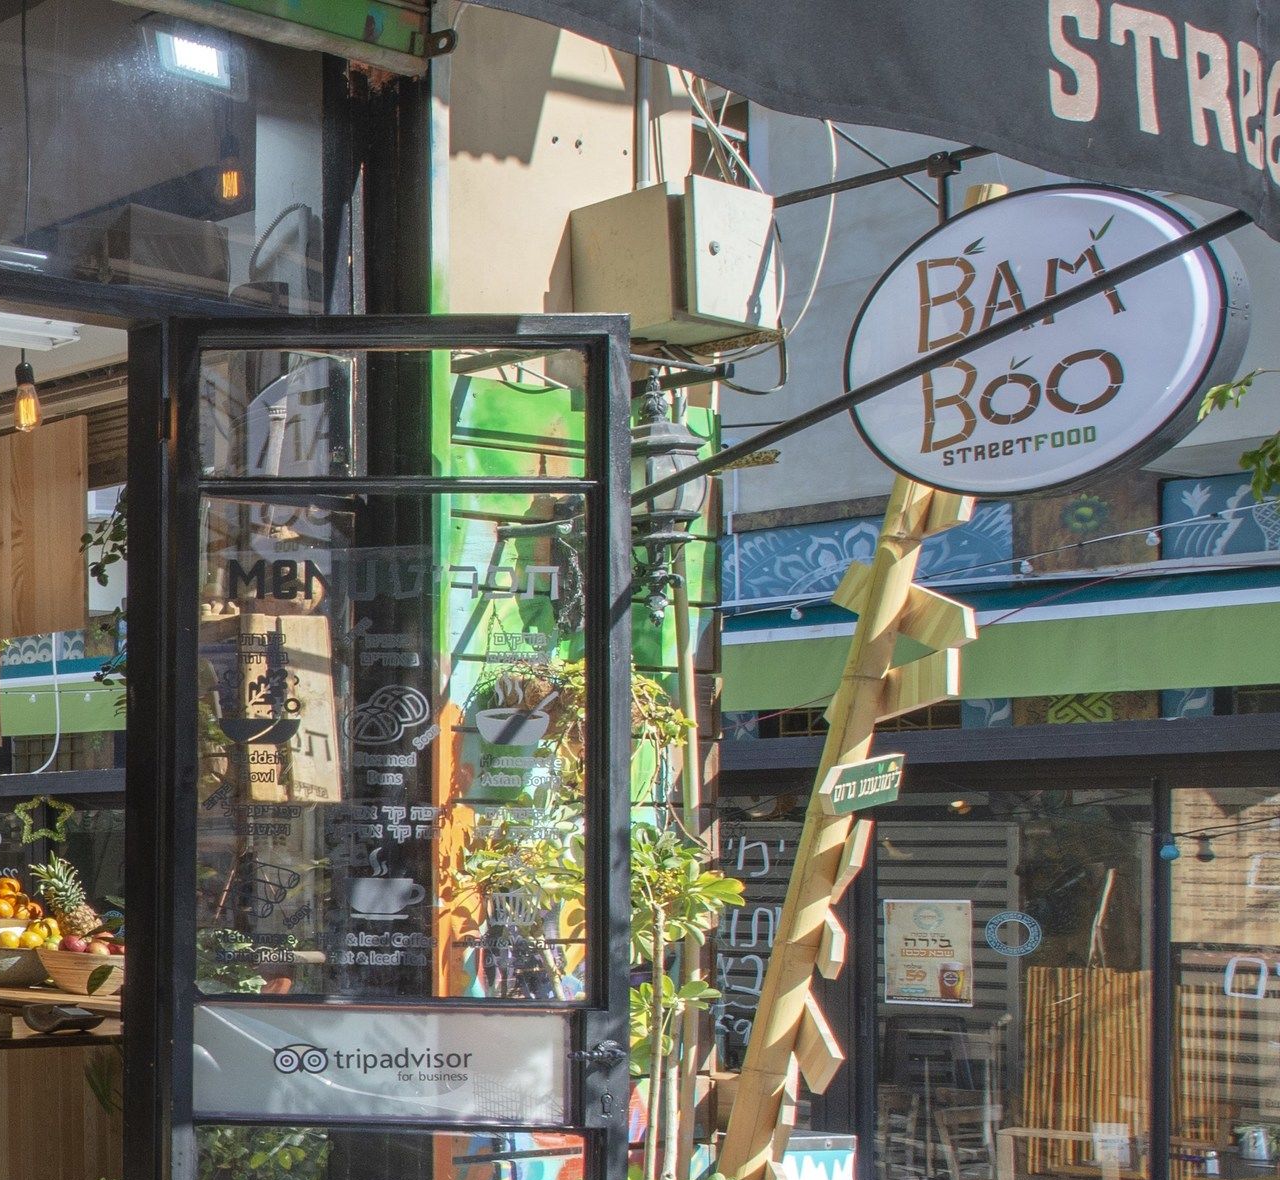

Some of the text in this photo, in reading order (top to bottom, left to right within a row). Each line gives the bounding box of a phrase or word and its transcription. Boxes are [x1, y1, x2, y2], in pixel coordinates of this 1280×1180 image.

[916, 238, 1127, 353] BAM
[920, 350, 1125, 455] BOO
[904, 937, 953, 948] בירה
[334, 1045, 474, 1075] tripadvisor
[397, 1070, 469, 1083] for business
